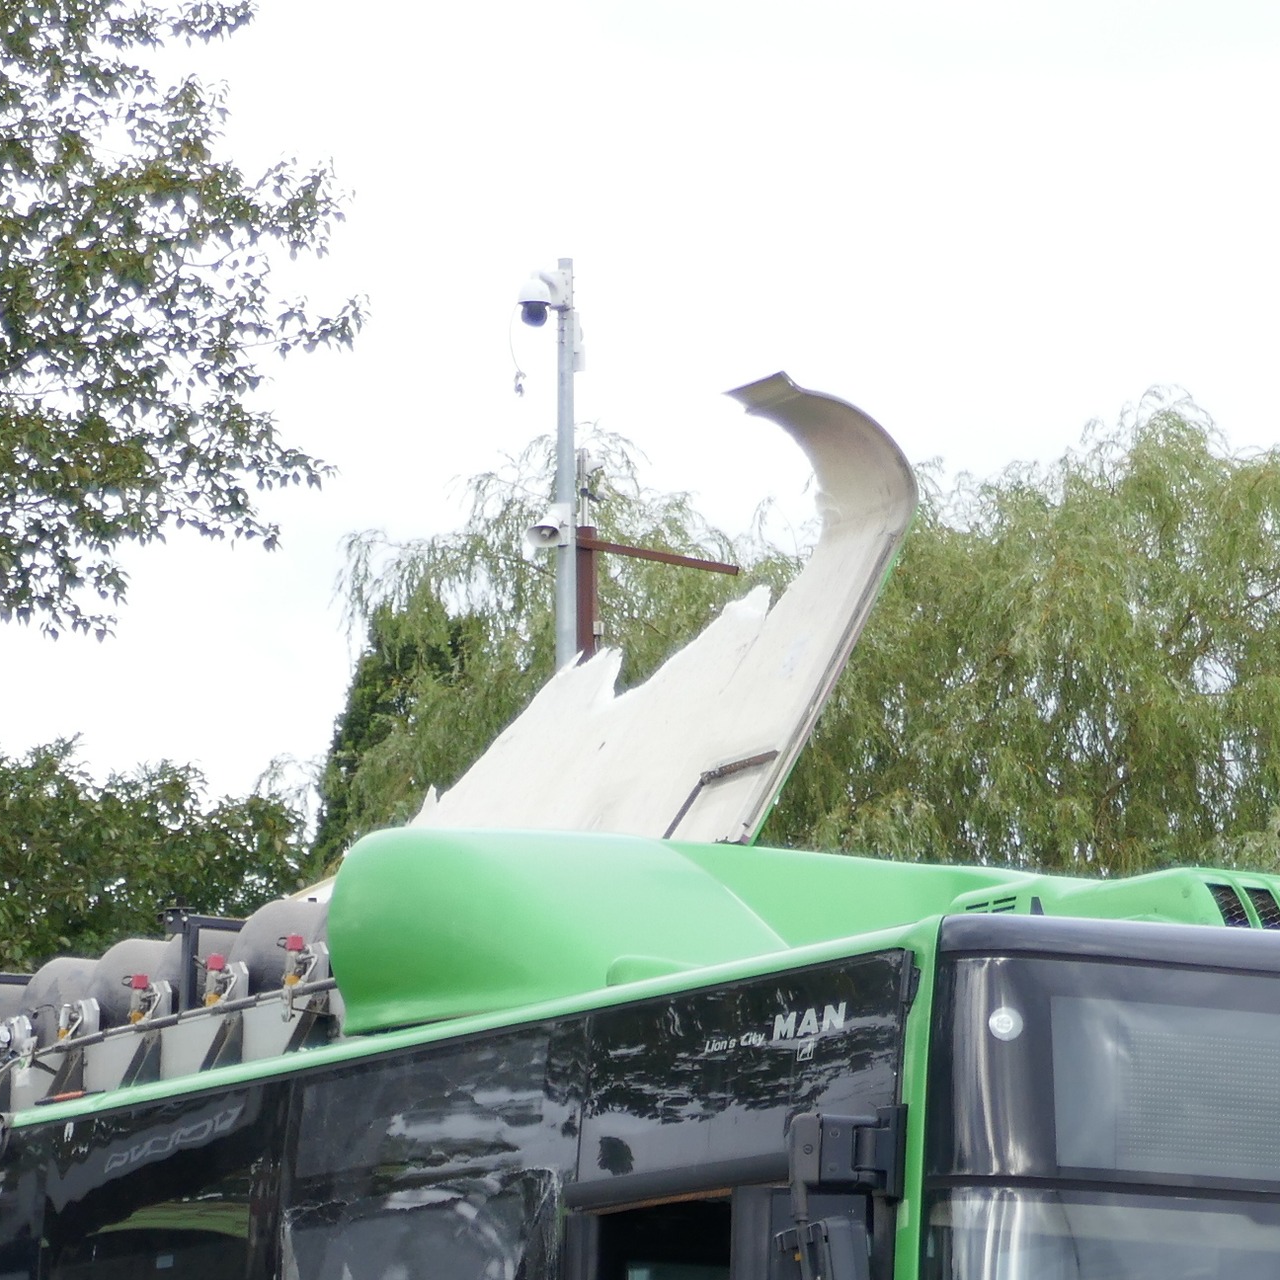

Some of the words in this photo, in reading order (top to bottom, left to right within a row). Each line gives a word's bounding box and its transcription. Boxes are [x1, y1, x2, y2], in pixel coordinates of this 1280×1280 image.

[704, 1035, 736, 1053] Lion's
[740, 1031, 766, 1046] City
[772, 1001, 847, 1041] MAN
